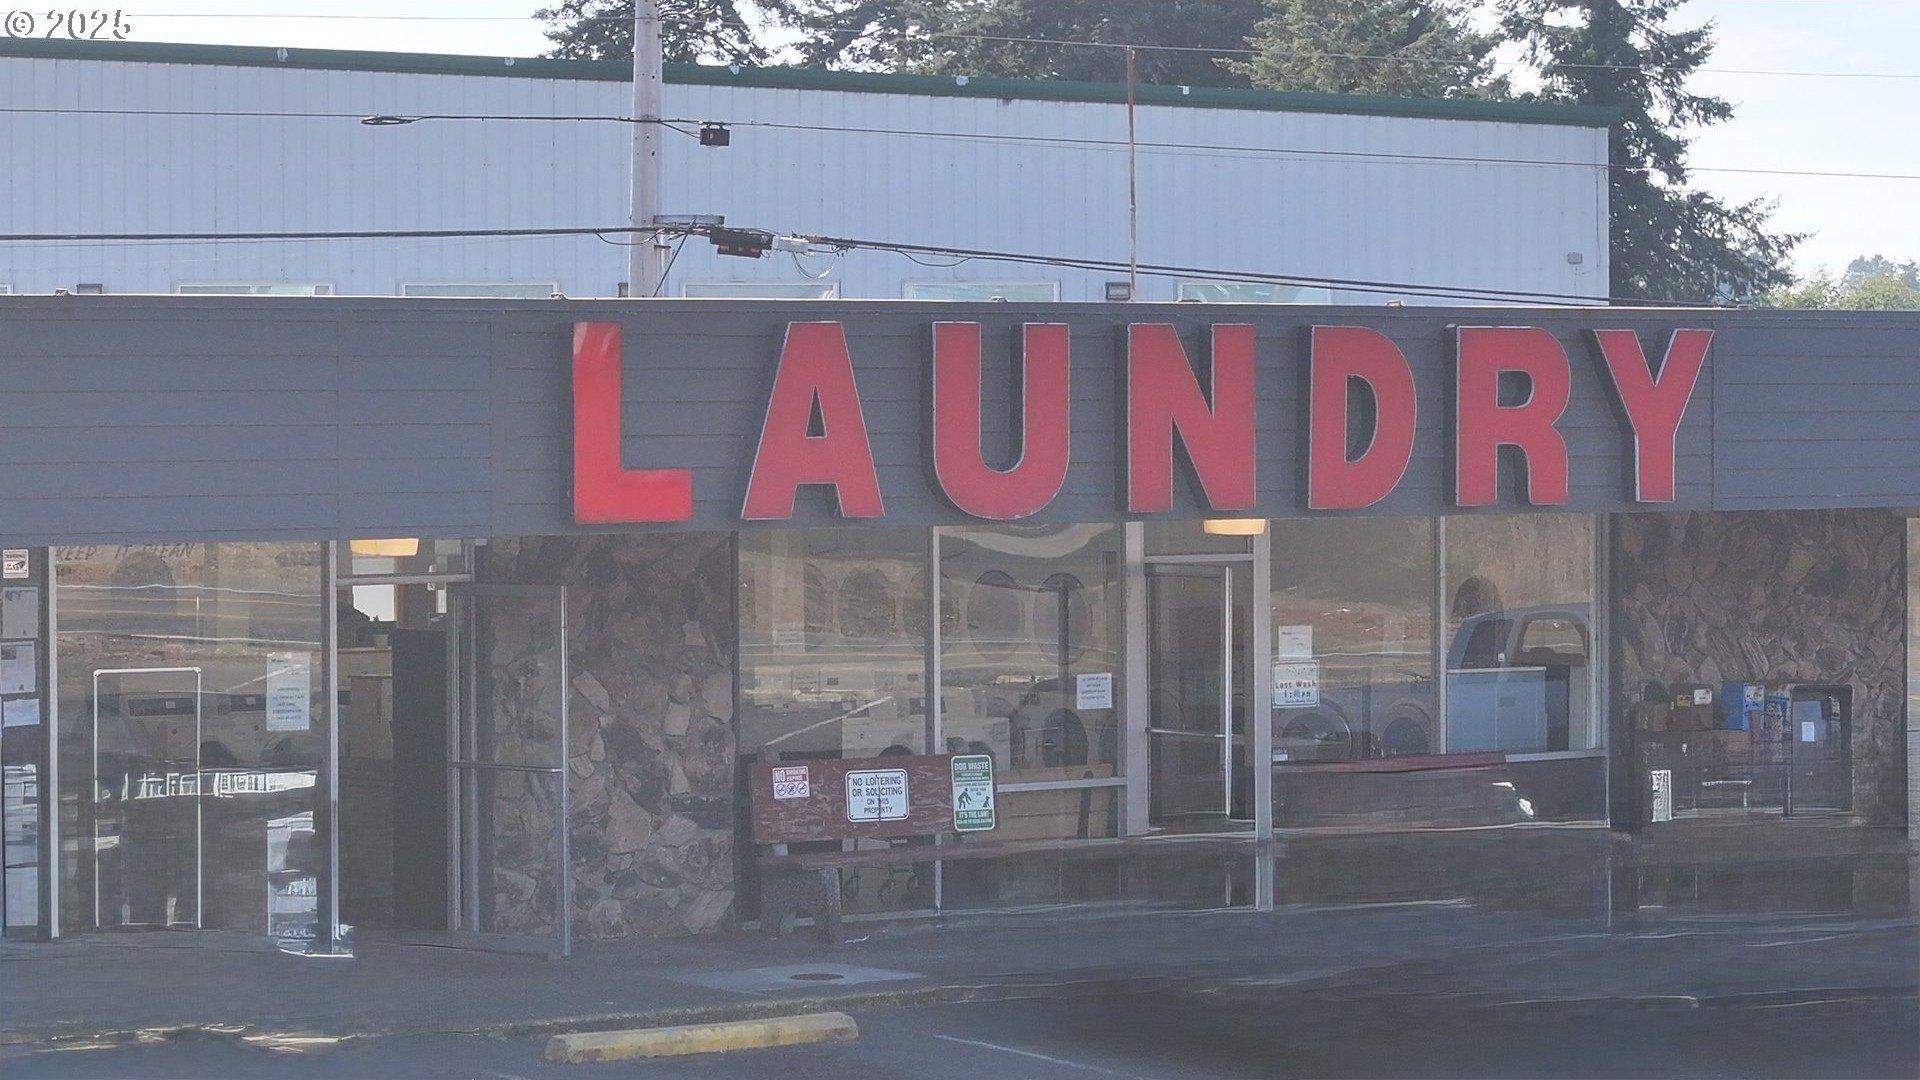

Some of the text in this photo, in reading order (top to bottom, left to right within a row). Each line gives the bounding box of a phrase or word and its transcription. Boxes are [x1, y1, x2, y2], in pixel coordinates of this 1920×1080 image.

[572, 320, 1715, 523] LAUNDRY
[968, 761, 989, 770] WASTE
[774, 769, 786, 782] NO
[852, 776, 902, 787] NO LOITERING
[852, 786, 903, 797] OR SOLICITING
[866, 798, 875, 806] ON
